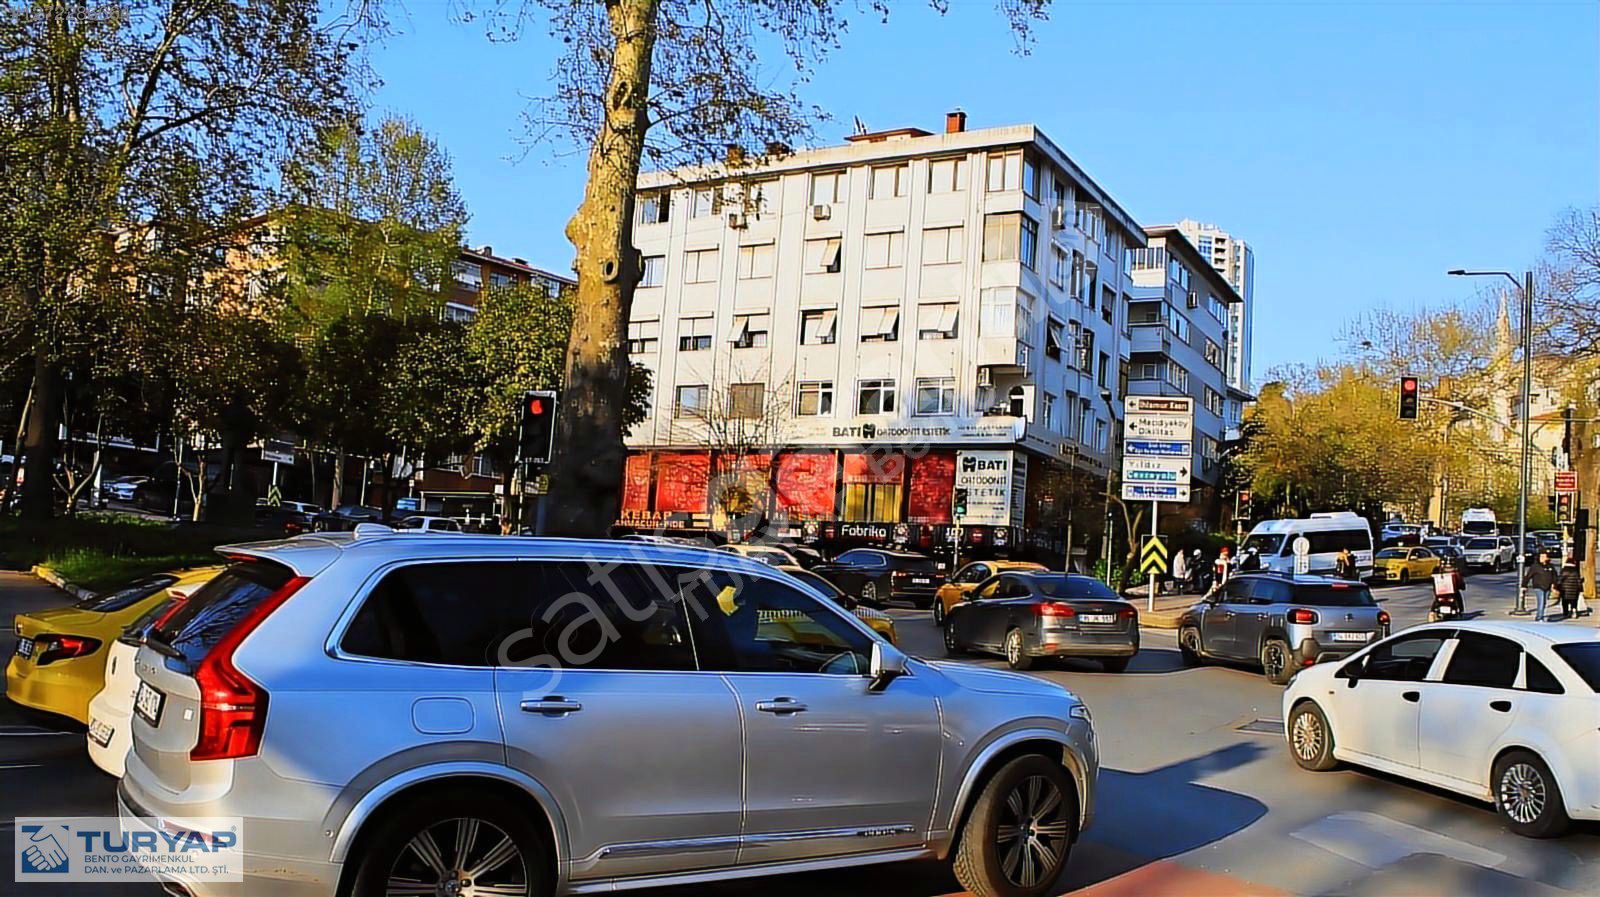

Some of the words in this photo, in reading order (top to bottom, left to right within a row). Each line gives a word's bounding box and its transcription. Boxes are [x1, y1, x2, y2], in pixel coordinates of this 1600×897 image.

[832, 427, 861, 437] BATI
[977, 460, 1007, 470] BATI
[967, 487, 1006, 497] STETİK
[620, 508, 673, 520] KEBAP
[841, 524, 887, 538] Fabrika
